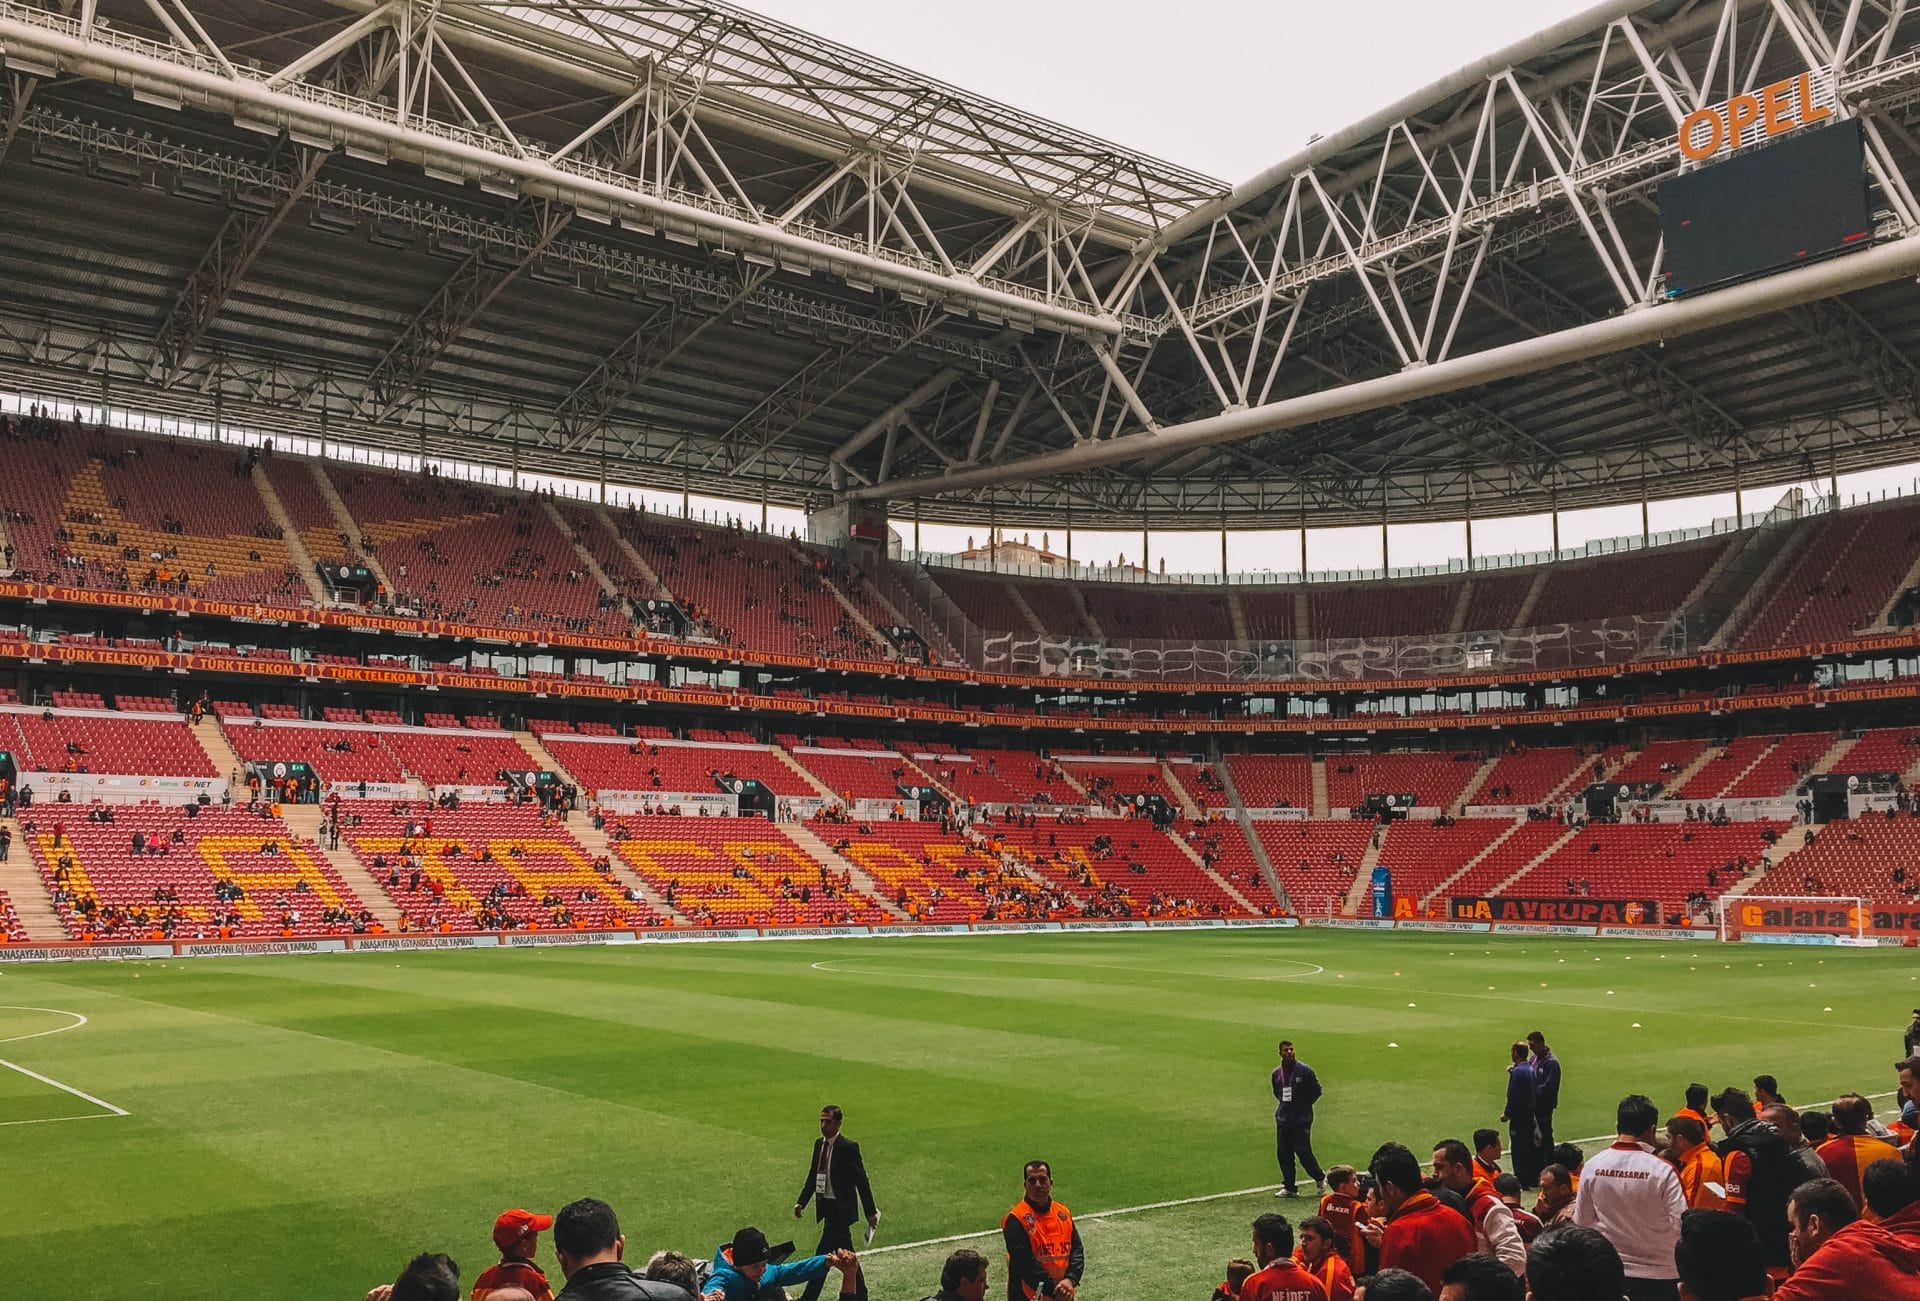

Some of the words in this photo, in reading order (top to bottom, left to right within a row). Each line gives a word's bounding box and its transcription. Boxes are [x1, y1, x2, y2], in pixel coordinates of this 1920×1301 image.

[1679, 72, 1831, 160] OPEL
[62, 589, 98, 602] TÜRK
[102, 593, 164, 608] TELEKOM
[204, 602, 237, 614] TÜRK
[240, 606, 296, 620] TEEKOM
[333, 614, 362, 627] TÜRK
[365, 618, 417, 631] TELEKOM
[450, 625, 479, 636] TÜRK
[481, 629, 528, 641] TELEKOM
[559, 635, 585, 647] TÜRK
[586, 638, 630, 650] TELEKOM
[1832, 642, 1859, 652] TÜRK
[1861, 637, 1913, 650] TELEKOM
[58, 648, 94, 660] TÜRK
[98, 652, 160, 666] TELEKOM
[658, 644, 682, 654] TÜRK
[682, 647, 723, 659] TELEKOM
[1726, 653, 1751, 664] TÜRK
[1754, 648, 1800, 661] TELEKOM
[202, 657, 234, 670] TÜRK
[236, 664, 294, 674] TELEKOM
[750, 652, 771, 662] TÜRK
[772, 656, 810, 666] TELEKOM
[1629, 662, 1654, 673] TÜRK
[1654, 658, 1697, 670] TELEKOM
[834, 660, 854, 671] TÜRK
[856, 663, 891, 673] TELEKOM
[330, 667, 362, 680] TÜRK
[365, 670, 416, 683] TELEKOM
[913, 669, 932, 678] TÜRK
[934, 671, 966, 682] TELEKOM
[450, 676, 478, 687] TÜRK
[479, 679, 526, 690] TELEKOM
[558, 684, 582, 695] TÜRK
[584, 687, 628, 698] TELEKOM
[657, 691, 680, 701] TÜRK
[681, 694, 722, 704] TELEKOM
[1835, 690, 1862, 700] TÜRK
[1865, 686, 1916, 698] TELEKOM
[749, 698, 771, 708] TÜRK
[772, 701, 810, 711] TELEKOM
[1632, 706, 1656, 716] TÜRK
[1658, 703, 1699, 714] TELEKOM
[1729, 699, 1754, 709] TÜRK
[1756, 696, 1803, 707] TELEKOM
[834, 704, 854, 714] TÜRK
[856, 706, 891, 716] TELEKOM
[913, 710, 932, 719] TÜRK
[934, 712, 966, 722] TELEKOM
[1502, 903, 1619, 923] AVRUPA
[189, 946, 232, 954] ANASAYFANI
[1594, 1168, 1650, 1180] GALATASARAY
